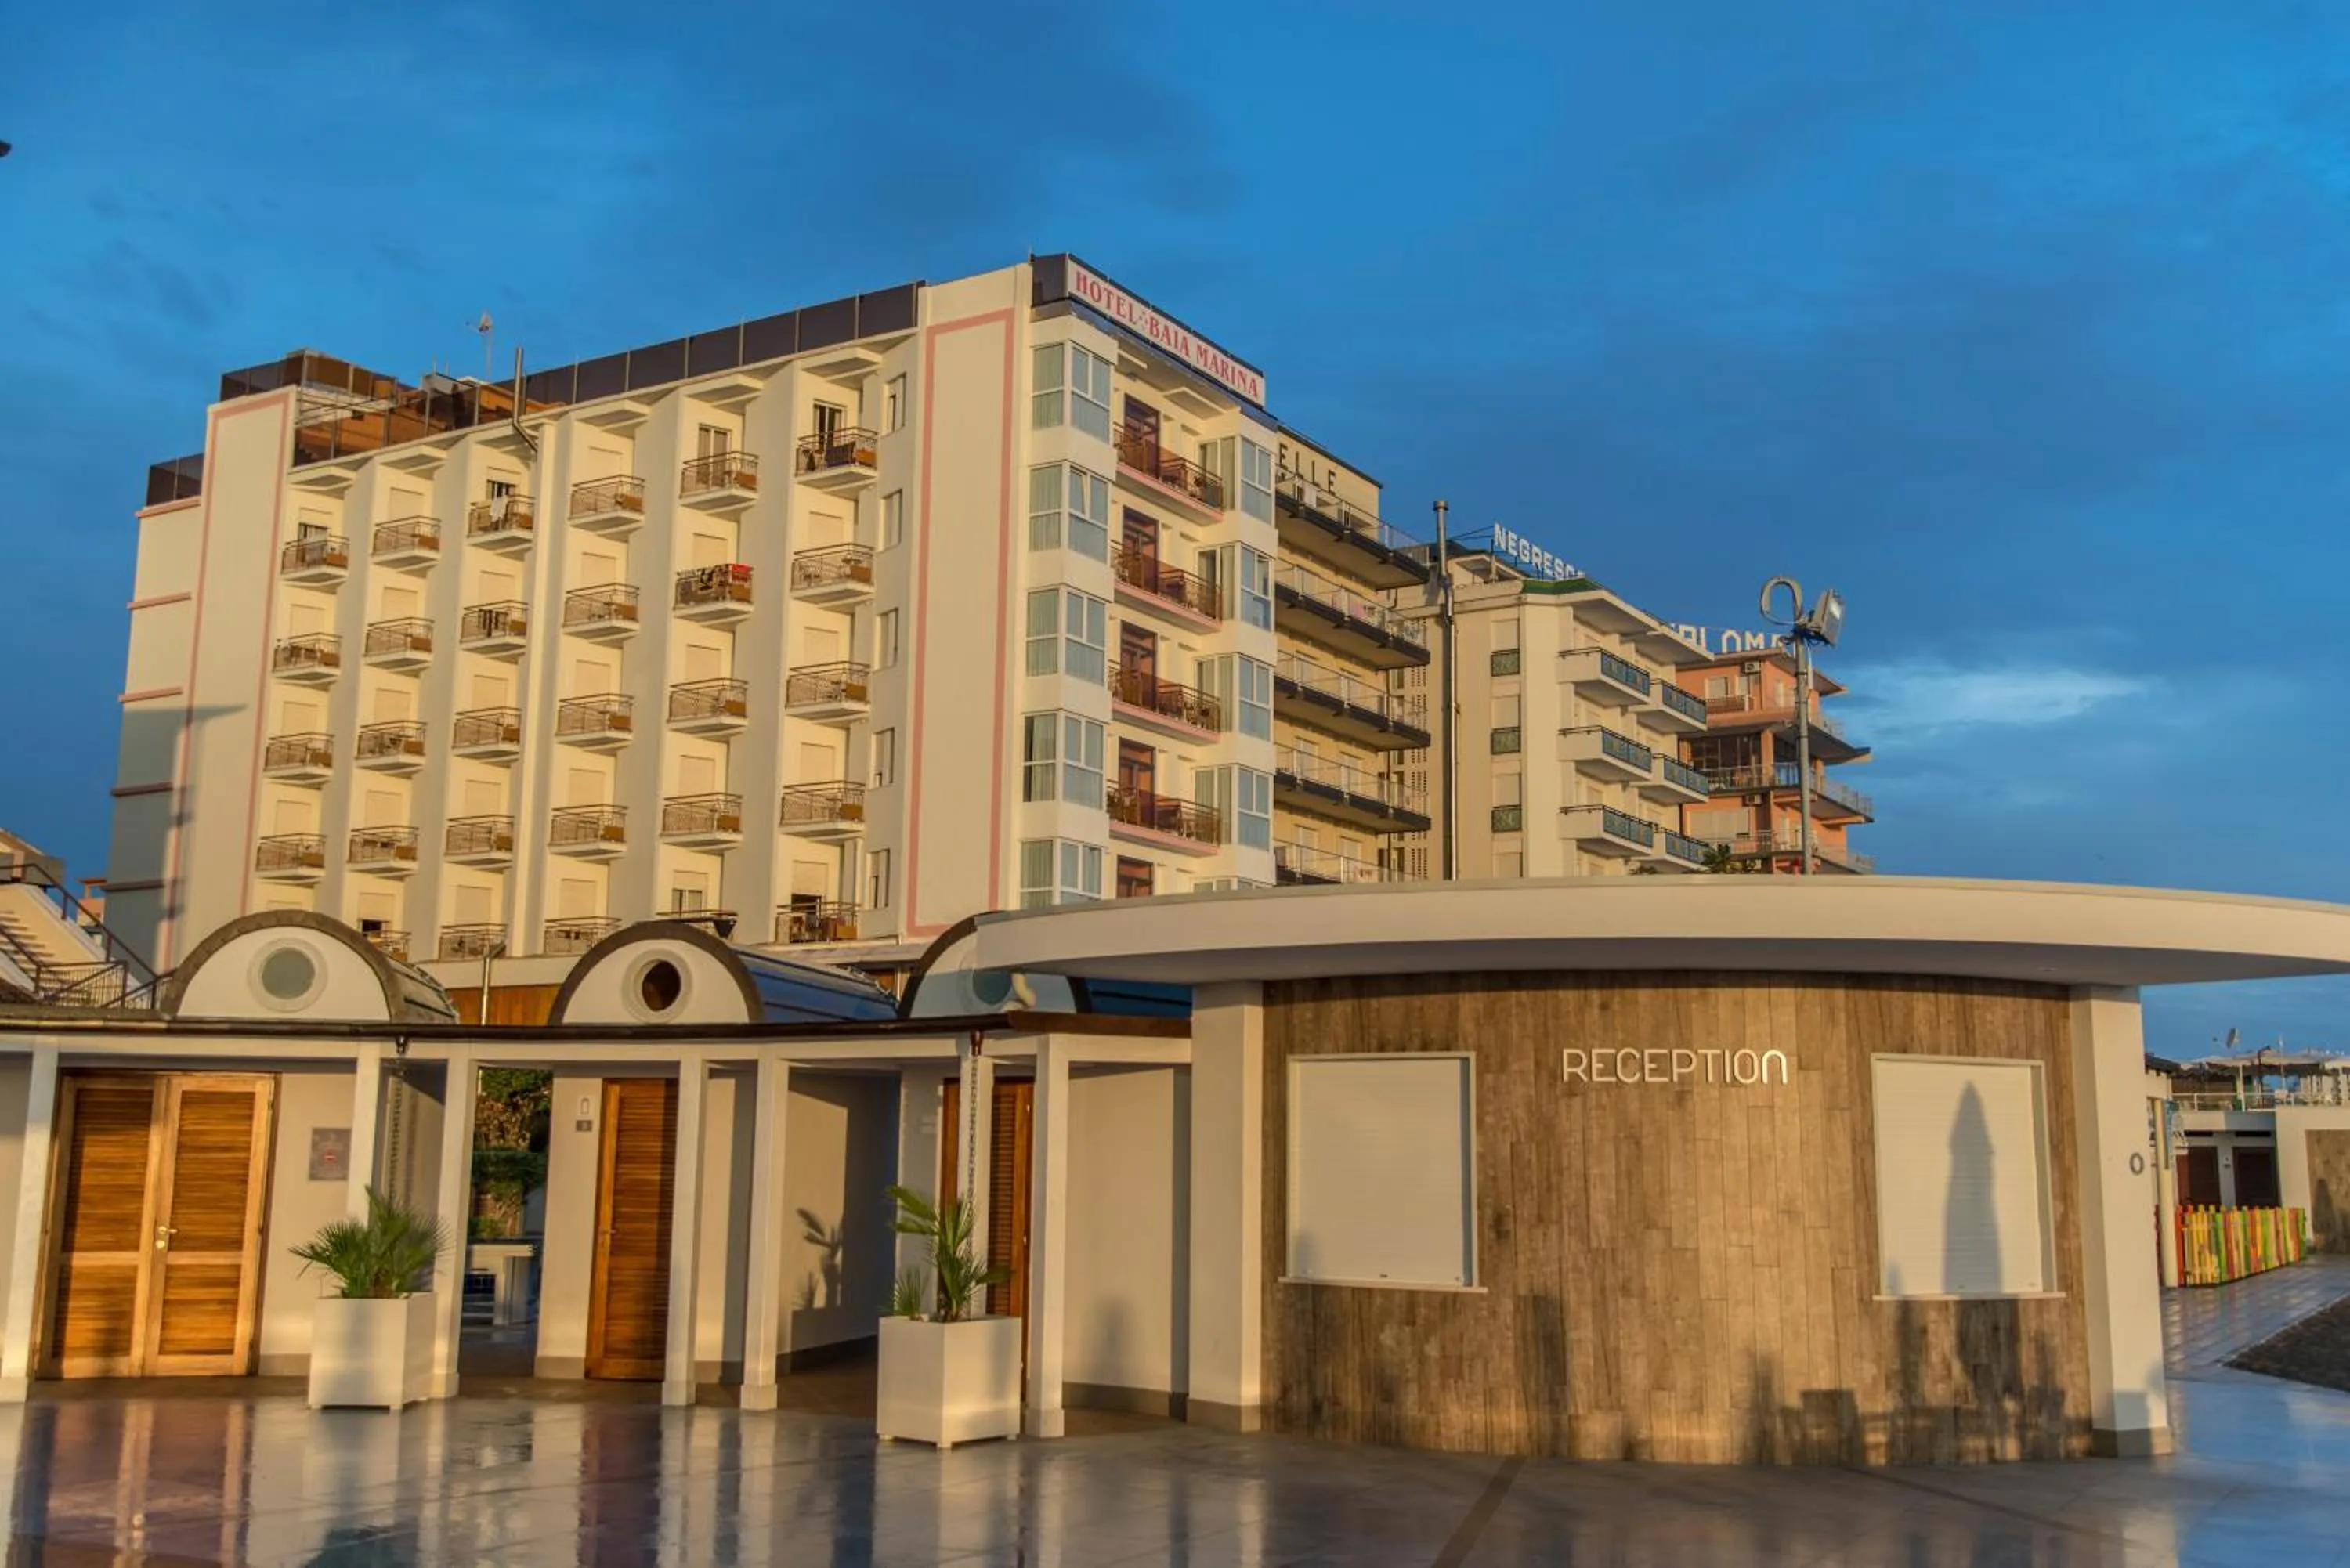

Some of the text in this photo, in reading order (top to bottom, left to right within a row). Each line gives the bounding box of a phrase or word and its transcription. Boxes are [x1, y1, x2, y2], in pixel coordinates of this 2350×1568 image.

[1076, 270, 1258, 398] HOTEL BAIA MARINA
[1494, 522, 1586, 580] NEGRESC
